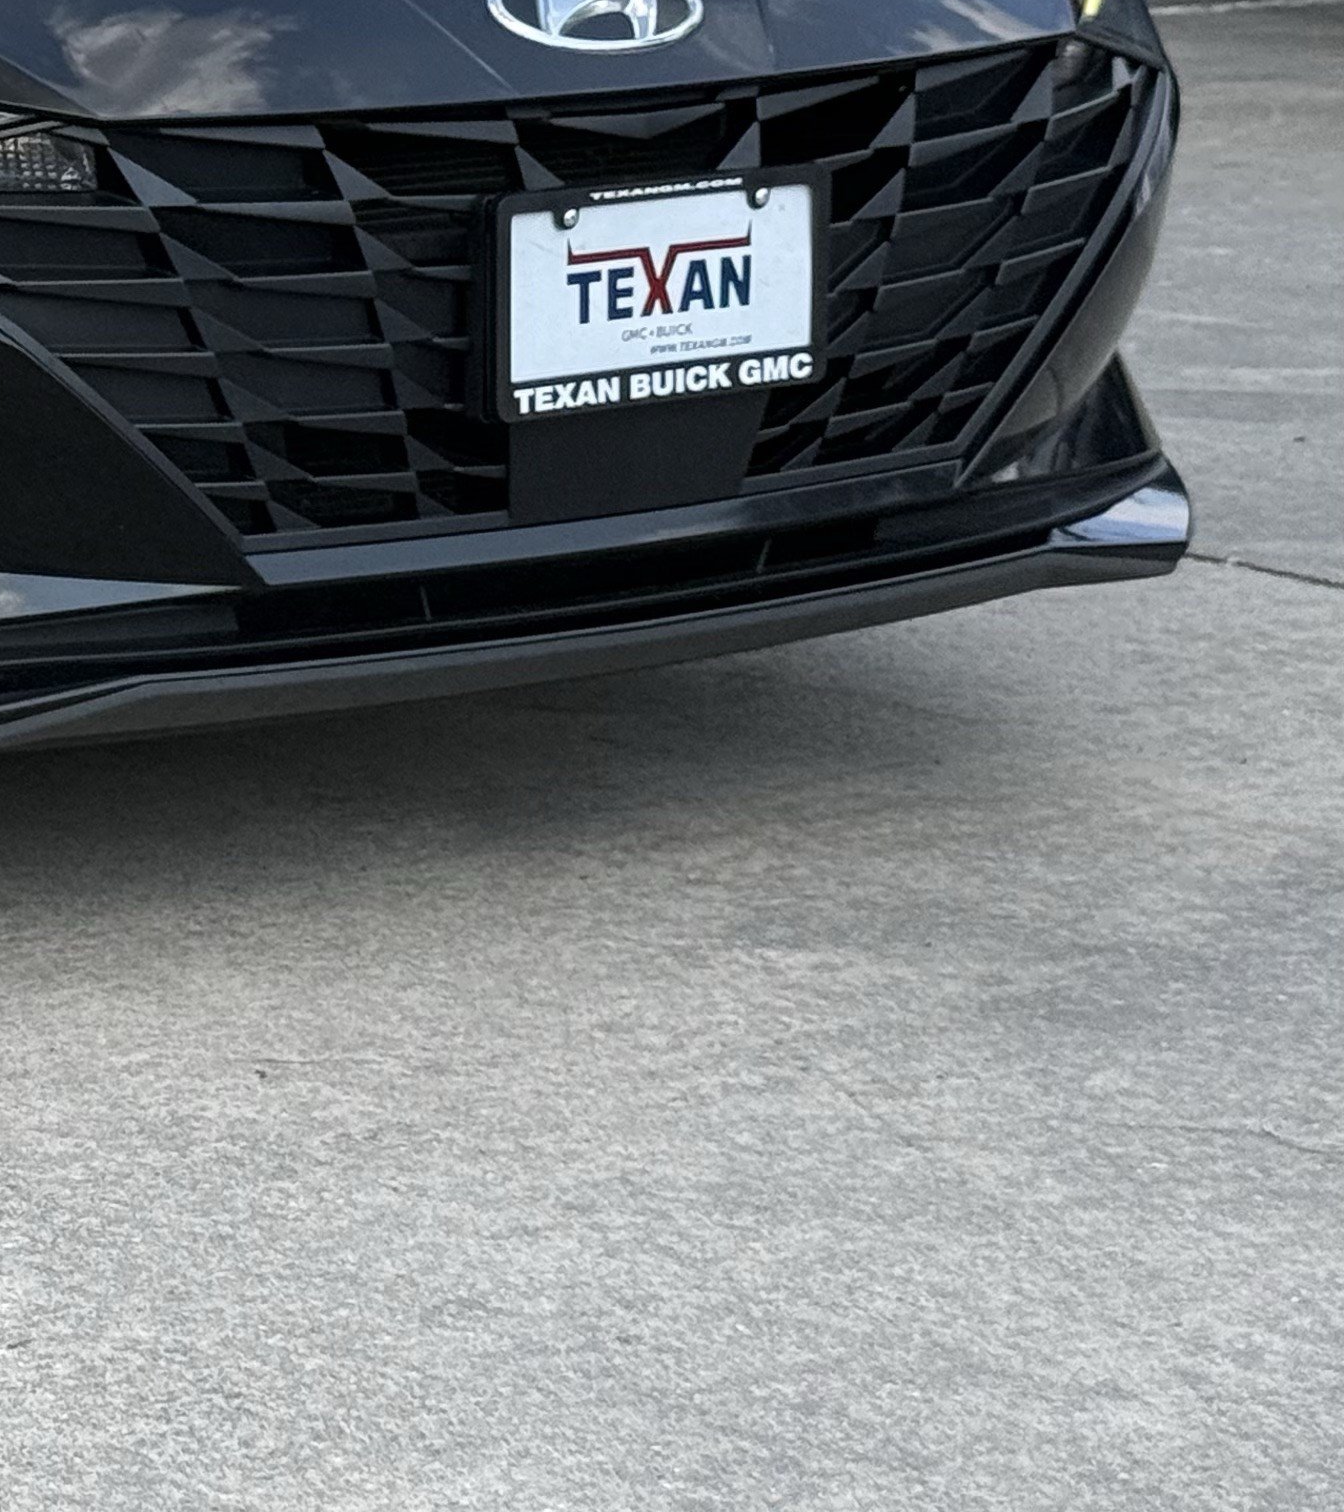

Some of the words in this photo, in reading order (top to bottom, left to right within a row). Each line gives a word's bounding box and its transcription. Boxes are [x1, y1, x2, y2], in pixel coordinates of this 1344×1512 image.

[566, 245, 752, 325] TEXAN
[621, 326, 648, 342] GMC
[656, 322, 693, 338] BUICK
[514, 377, 620, 414] TEXAN
[629, 363, 732, 400] BUICK
[738, 352, 814, 387] GMC
